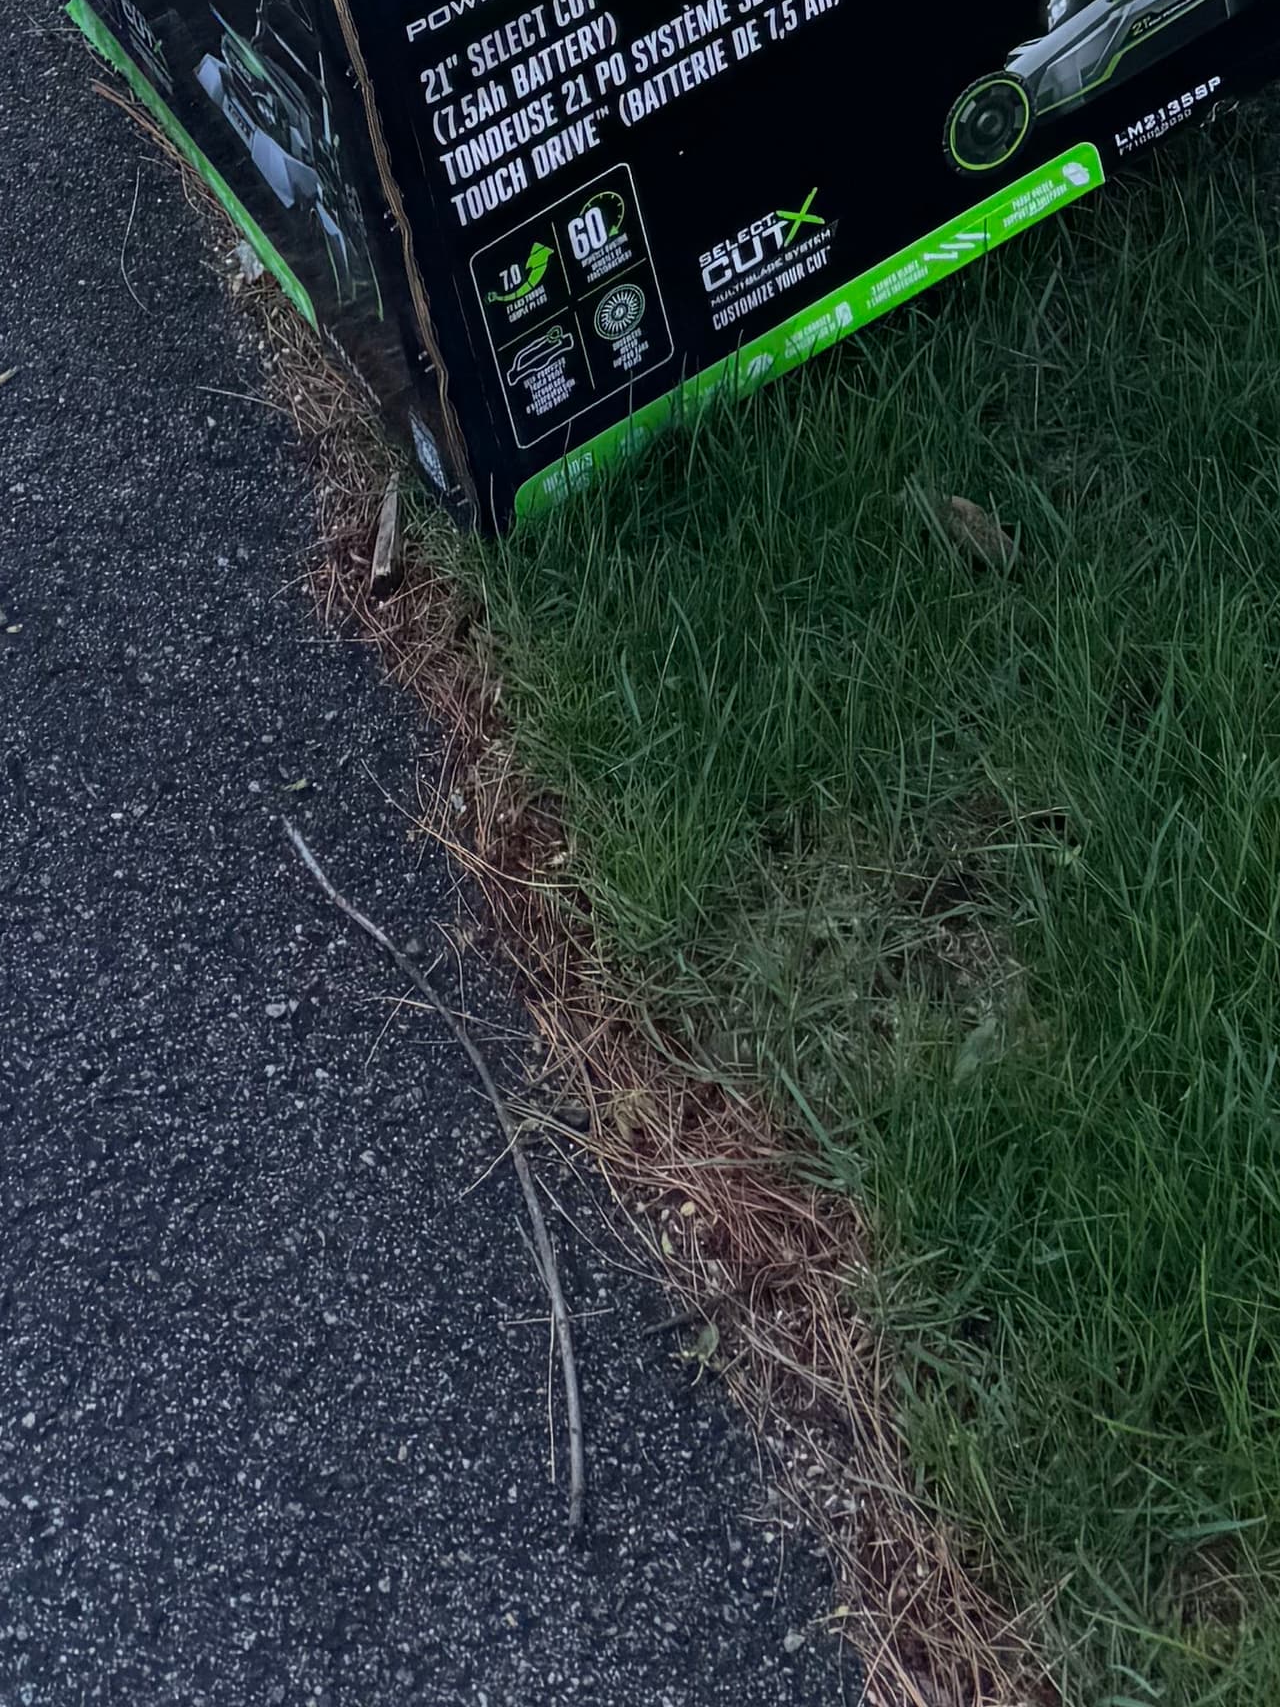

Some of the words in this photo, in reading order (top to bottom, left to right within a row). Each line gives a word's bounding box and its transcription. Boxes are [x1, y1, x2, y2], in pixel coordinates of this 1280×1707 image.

[467, 5, 546, 76] SELECT
[433, 81, 507, 145] (7.5Ah
[511, 12, 616, 99] BATTERY)
[440, 92, 564, 185] TONDEUSE
[562, 74, 592, 115] 21
[595, 53, 626, 95] PO
[451, 157, 527, 226] TOUCH
[619, 38, 728, 126] (BATTERIE
[732, 19, 762, 60] DE
[568, 206, 609, 260] 60
[700, 213, 777, 265] SELECT
[500, 264, 521, 291] 7.0
[713, 281, 774, 330] CUSTOMIZE
[775, 263, 805, 291] YOUR
